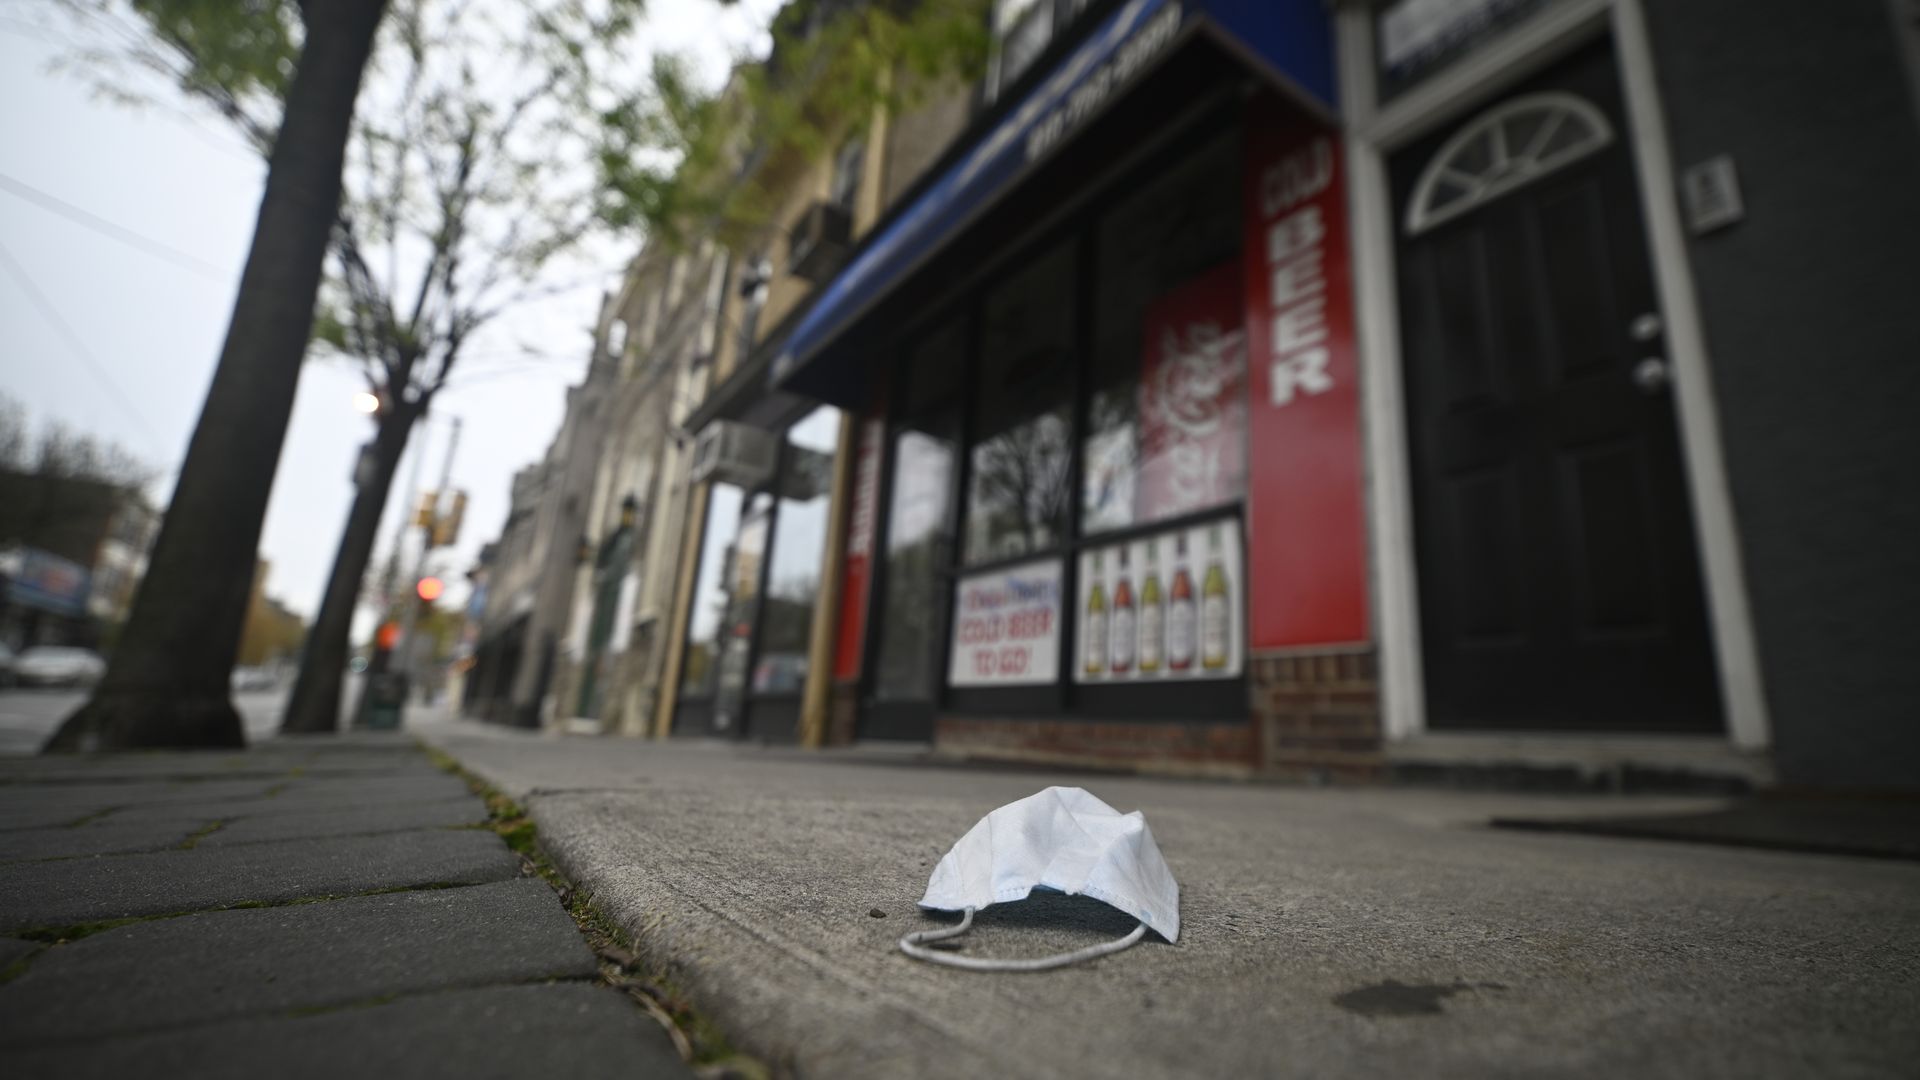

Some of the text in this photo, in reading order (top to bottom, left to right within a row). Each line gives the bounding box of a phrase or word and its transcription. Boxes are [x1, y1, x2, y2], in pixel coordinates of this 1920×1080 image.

[1261, 135, 1334, 221] COLD
[1267, 203, 1334, 408] BEER
[960, 605, 1054, 645] COLD BEER
[974, 649, 998, 677] TO
